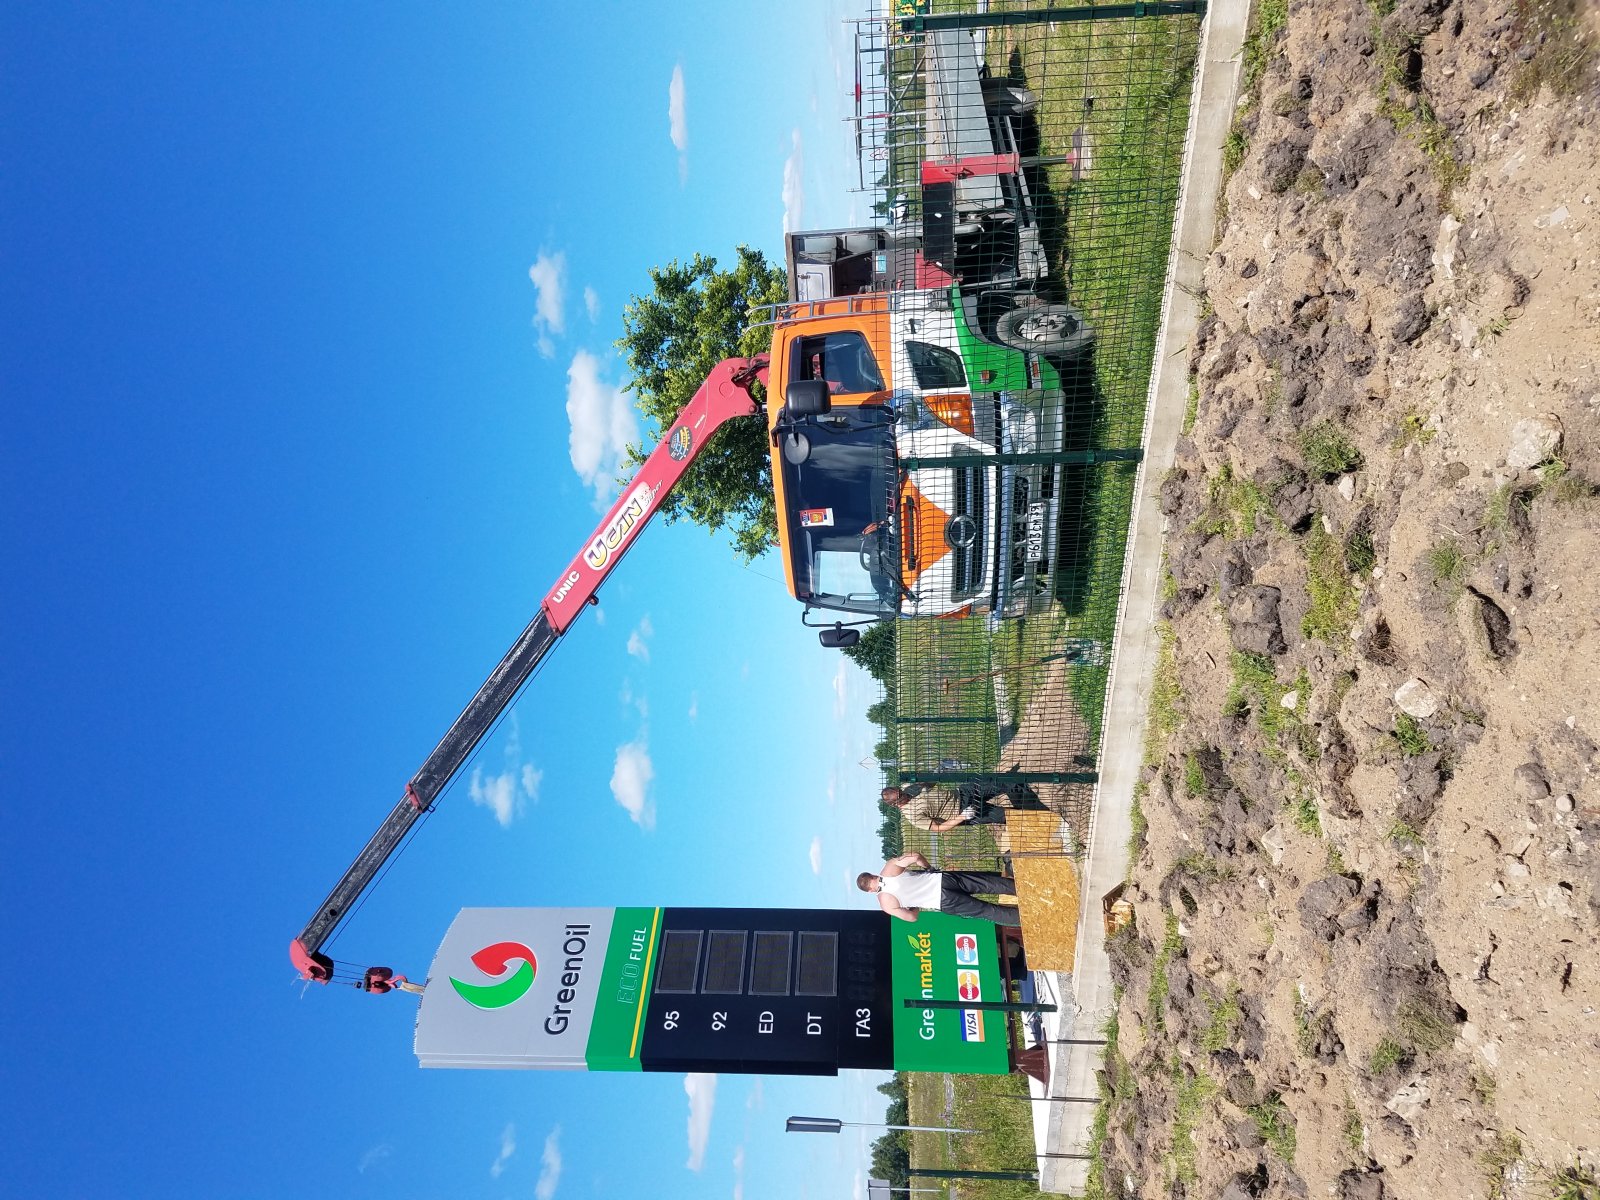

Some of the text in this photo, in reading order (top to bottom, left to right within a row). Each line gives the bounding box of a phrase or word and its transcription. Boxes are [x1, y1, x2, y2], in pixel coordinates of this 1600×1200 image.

[552, 570, 581, 604] UNIC
[616, 926, 647, 1004] ECO FUEL
[543, 924, 591, 1035] GreenOil
[914, 932, 935, 1041] Grenmarket
[664, 1010, 680, 1031] 95
[711, 1011, 727, 1031] 92
[758, 1010, 774, 1033] ED
[807, 1012, 822, 1035] DT
[856, 1008, 871, 1038] ГАЗ
[966, 1013, 978, 1036] VISA
